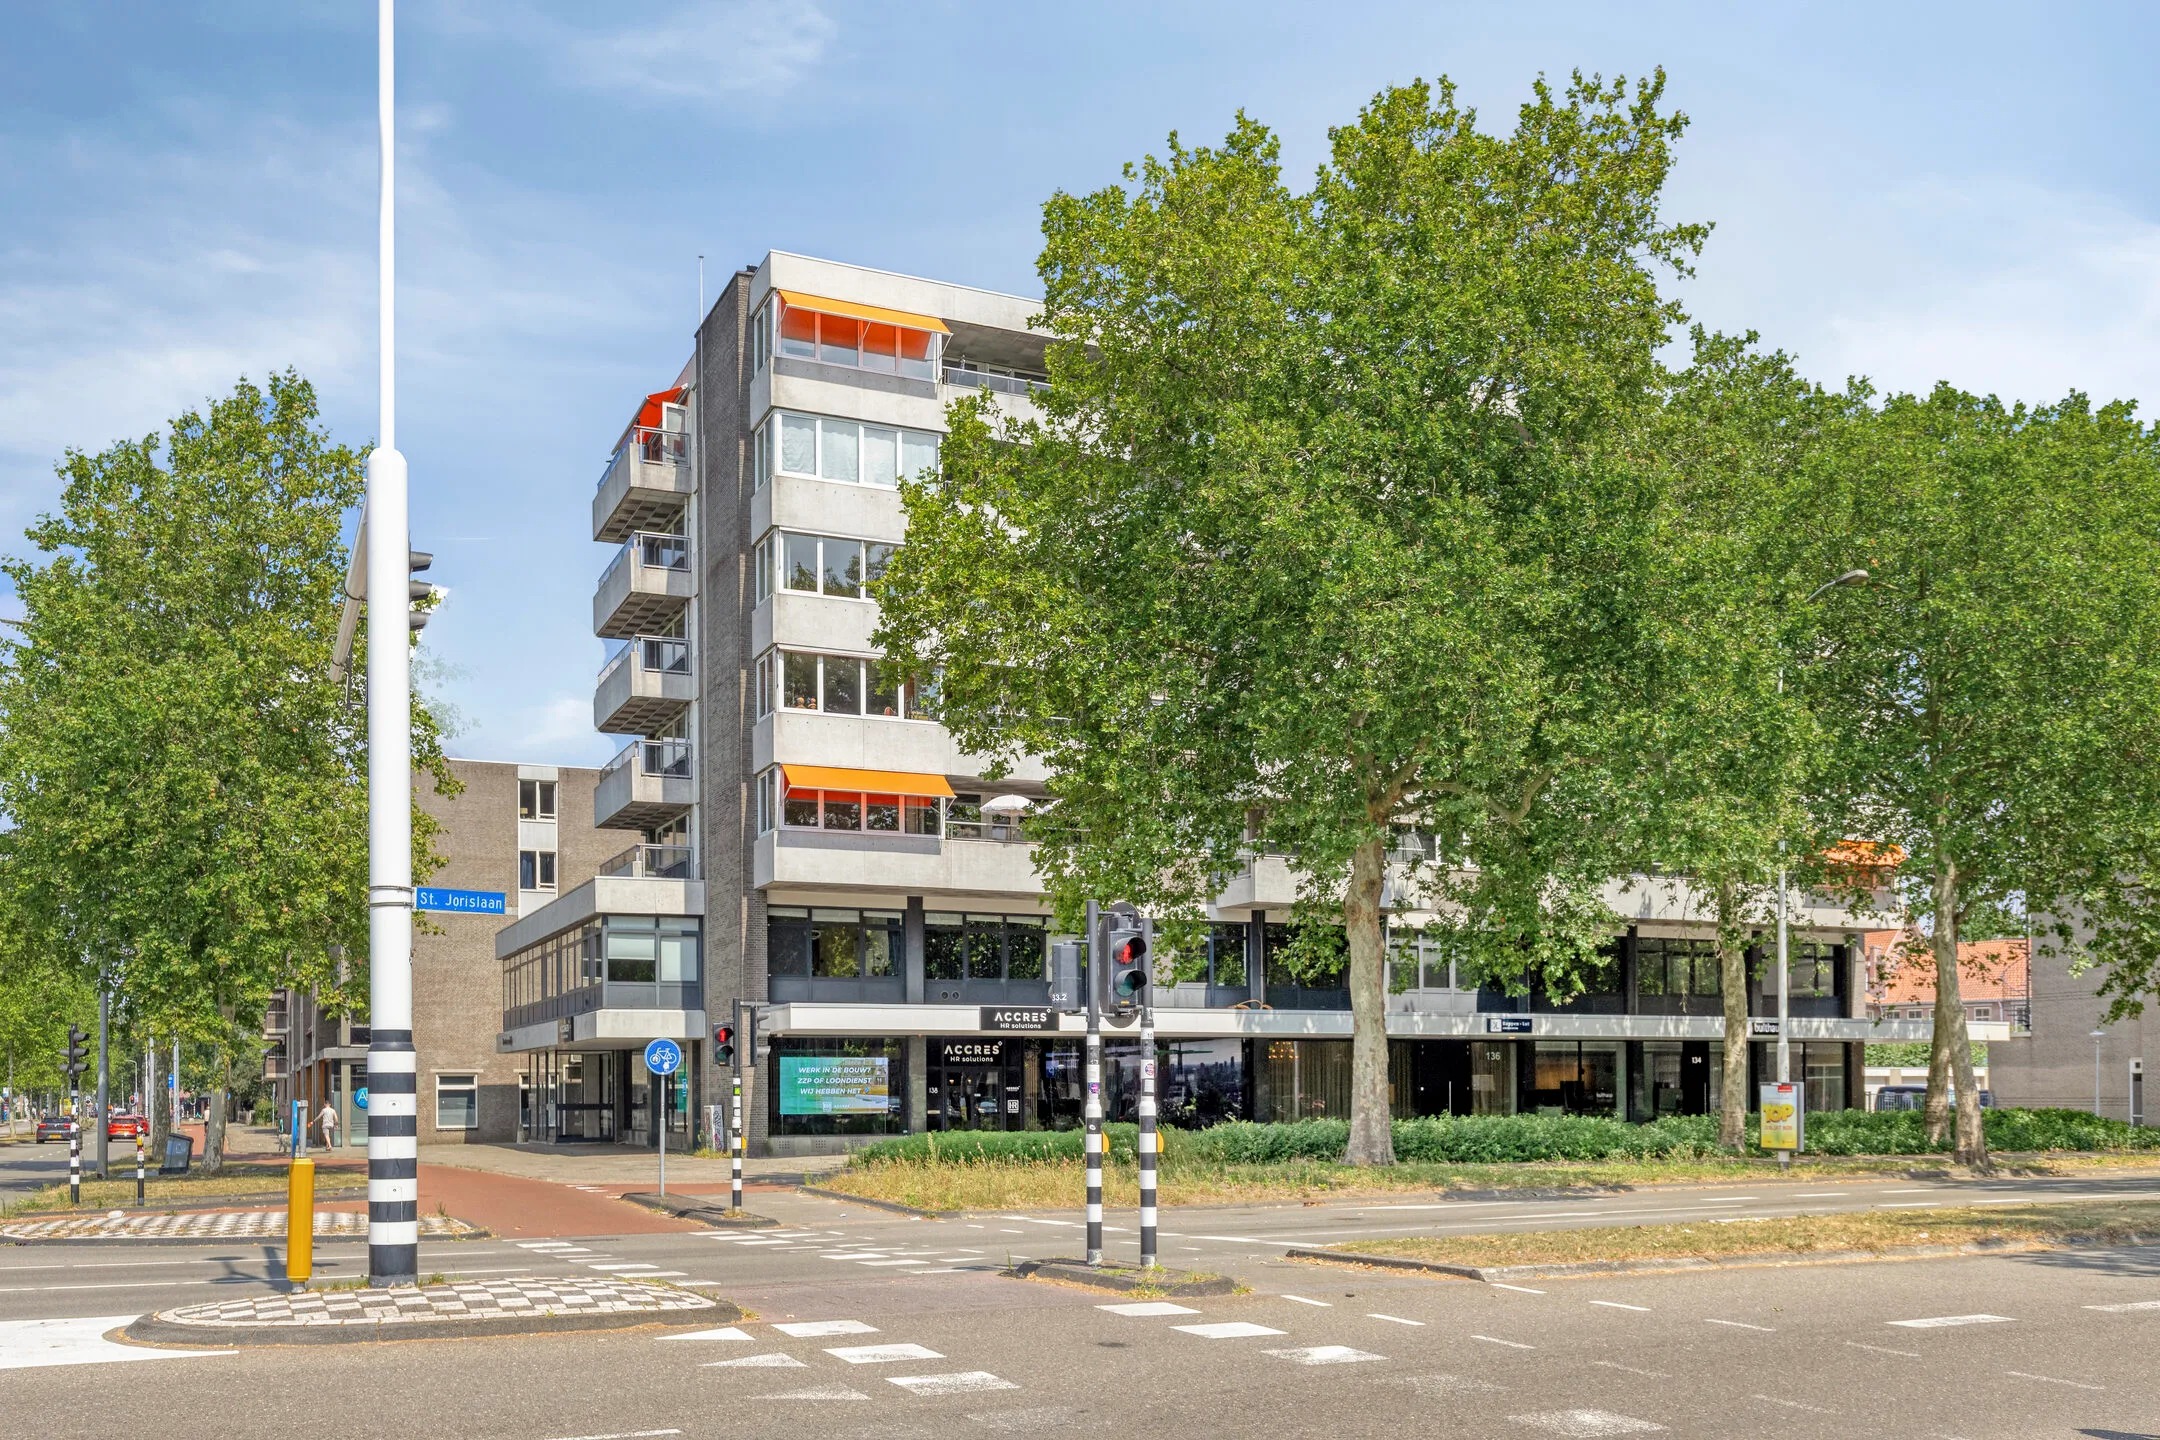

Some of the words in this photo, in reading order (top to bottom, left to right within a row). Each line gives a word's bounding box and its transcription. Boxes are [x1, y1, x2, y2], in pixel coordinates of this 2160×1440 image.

[420, 892, 438, 906] St.
[445, 893, 502, 910] Jorislaan
[994, 1011, 1047, 1022] ACCRES
[1754, 1022, 1780, 1033] bulthau
[944, 1044, 1000, 1055] ACCRES
[1486, 1051, 1501, 1061] 136
[1691, 1056, 1702, 1064] 134
[928, 1086, 939, 1094] 138
